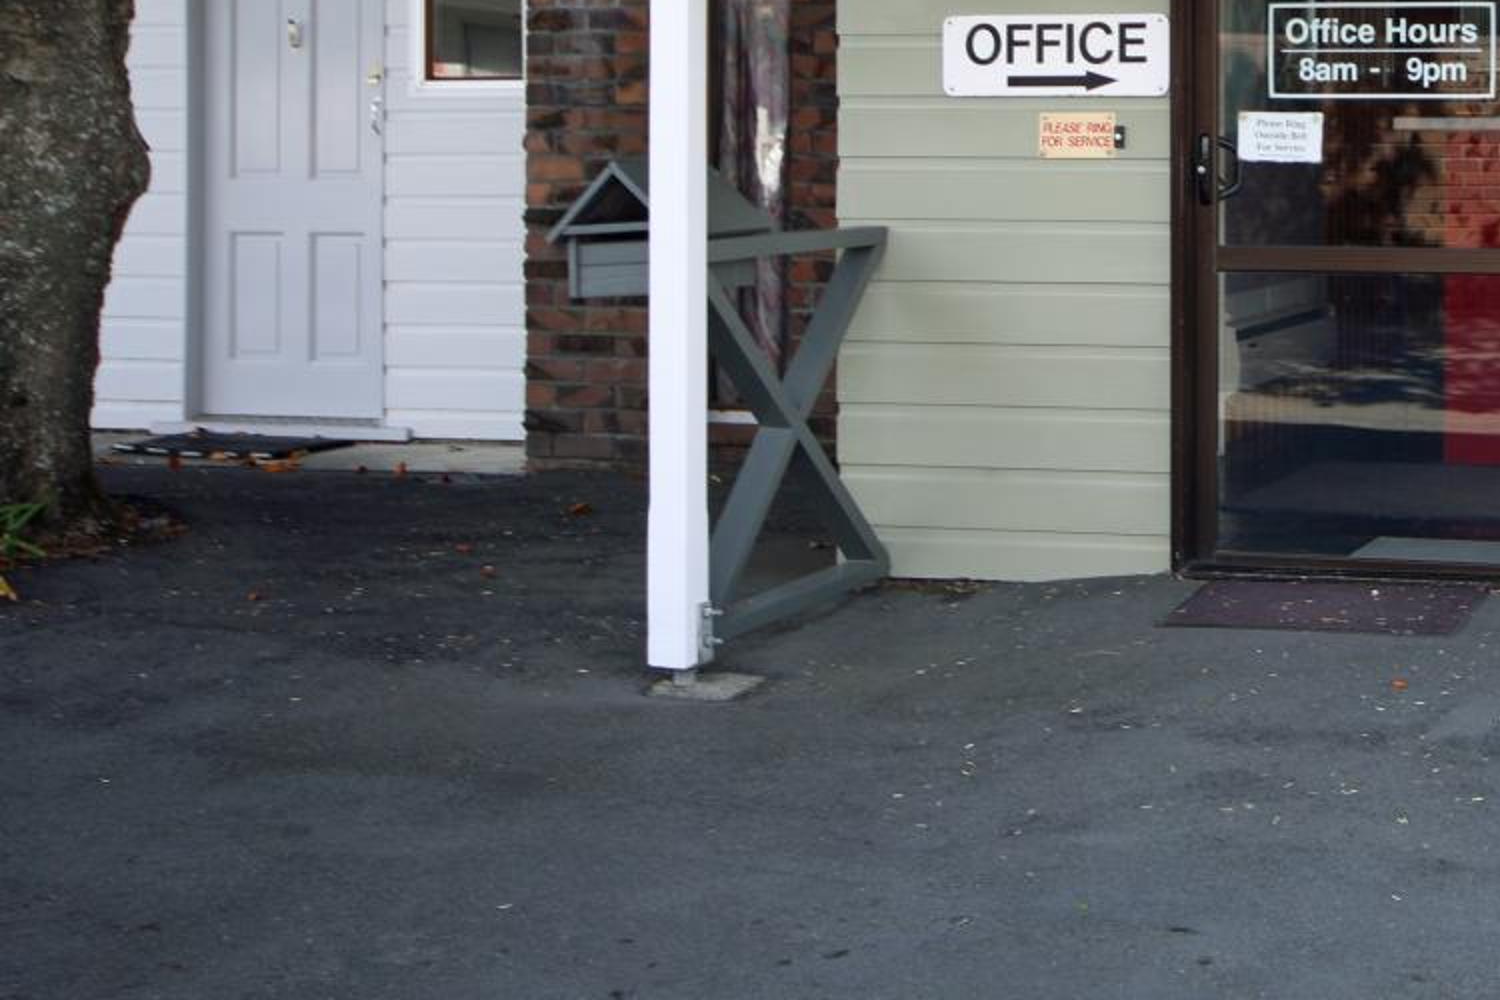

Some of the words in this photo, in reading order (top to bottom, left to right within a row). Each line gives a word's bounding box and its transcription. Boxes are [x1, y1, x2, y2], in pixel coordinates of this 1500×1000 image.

[965, 21, 1148, 66] OFFICE
[1285, 17, 1376, 45] Office
[1385, 17, 1478, 44] Hours
[1299, 57, 1358, 82] 8am
[1405, 56, 1467, 88] 9pm
[1041, 135, 1064, 147] FOR
[1067, 135, 1112, 147] SERVICE
[1042, 121, 1083, 133] PLEASE
[1086, 121, 1112, 133] RING
